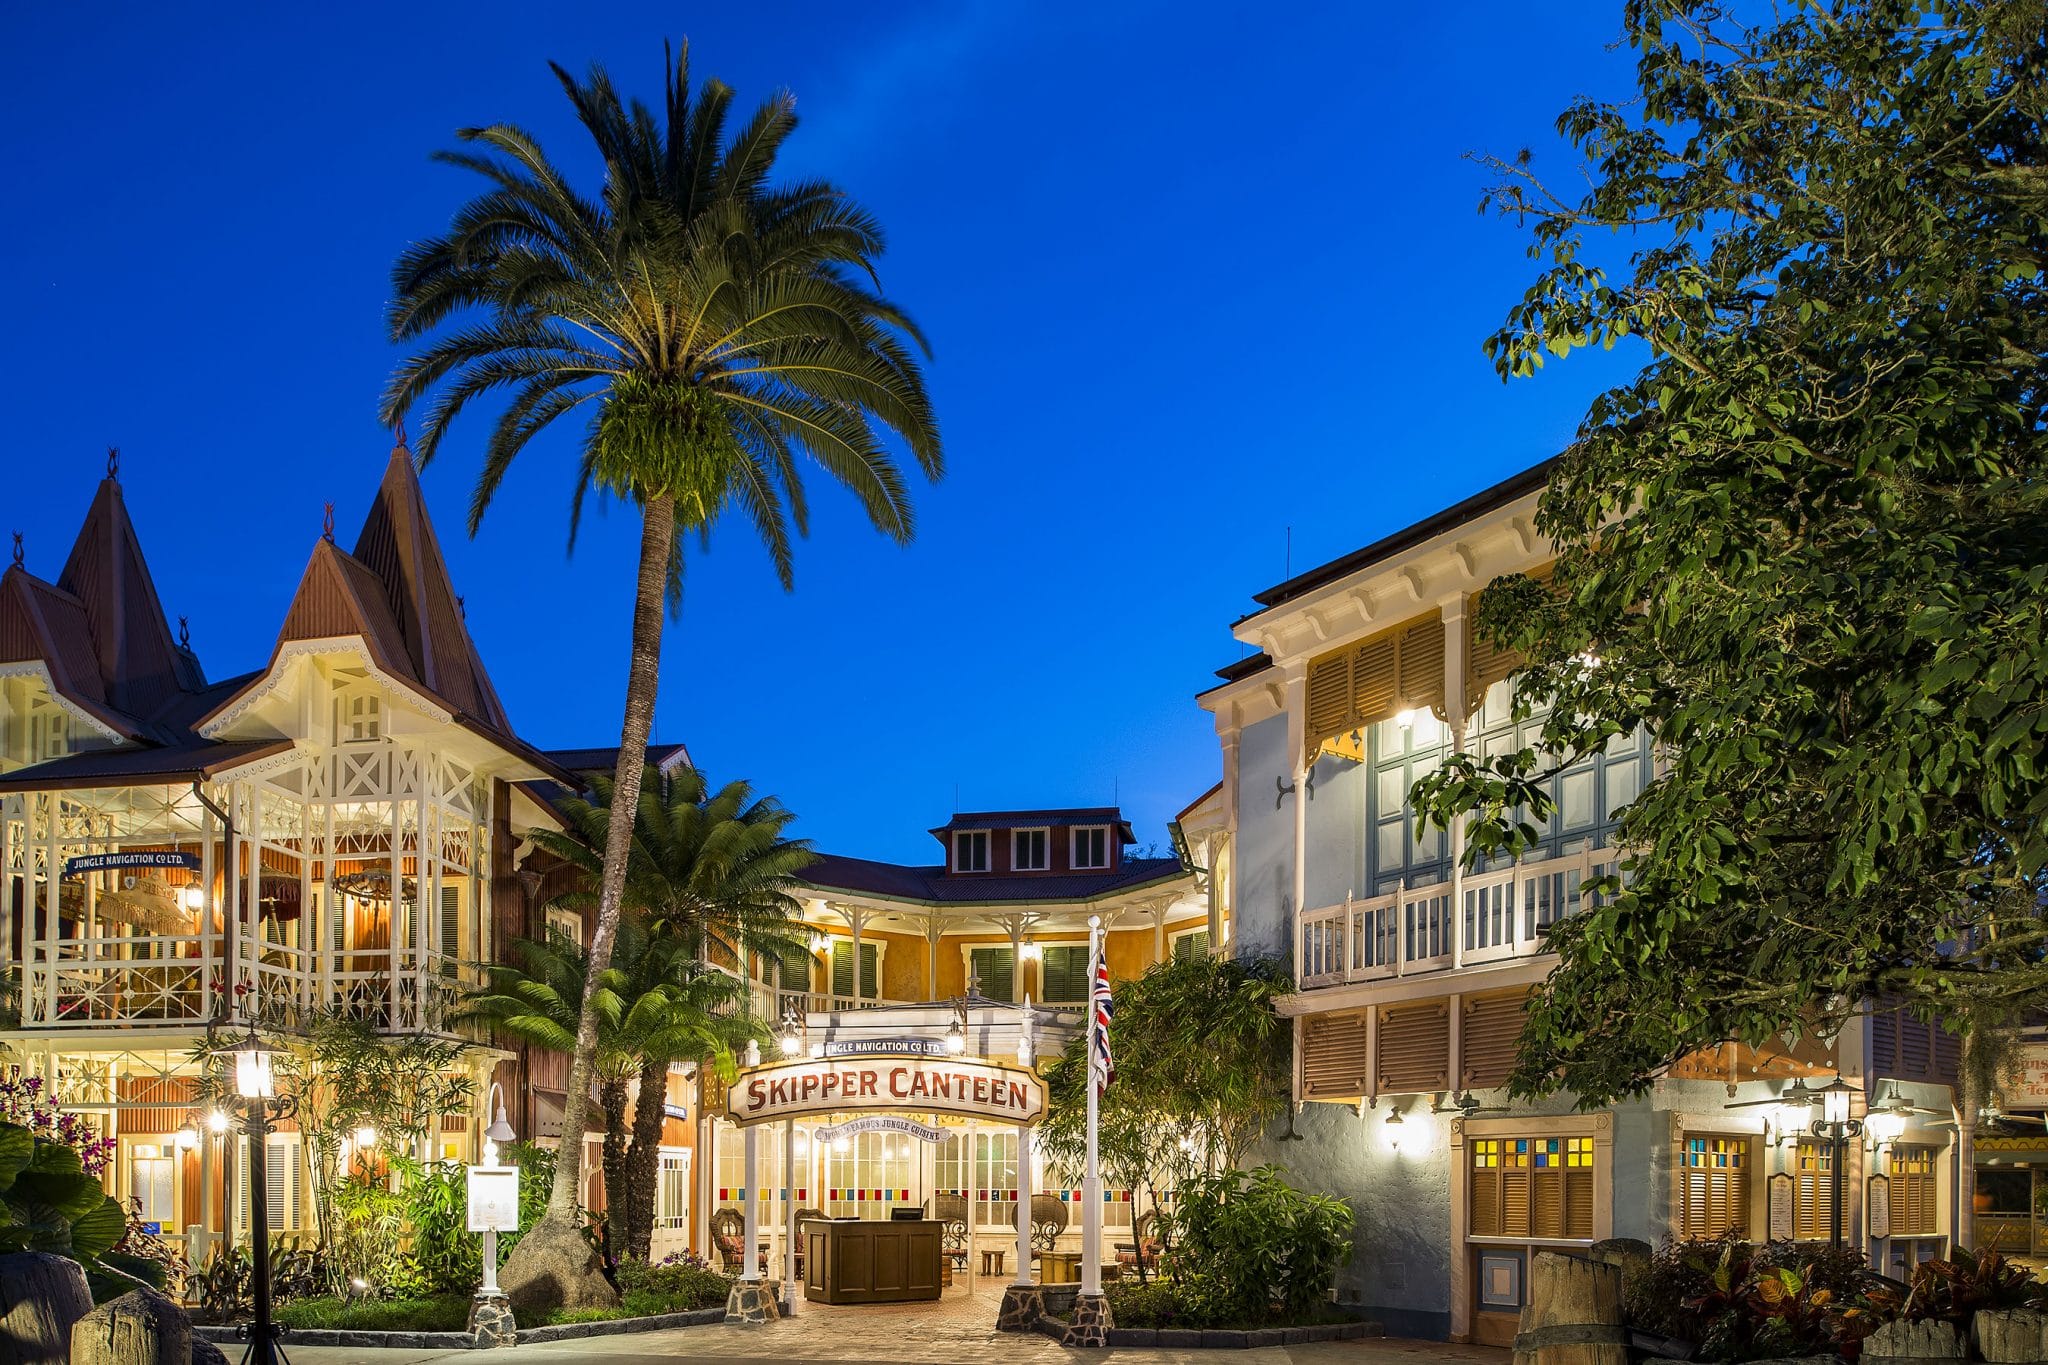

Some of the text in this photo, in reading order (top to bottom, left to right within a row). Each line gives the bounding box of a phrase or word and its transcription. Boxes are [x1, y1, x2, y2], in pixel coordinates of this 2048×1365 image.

[74, 857, 104, 869] JUNGLE
[106, 854, 154, 865] NAVIGATION
[825, 1043, 853, 1055] UNGLE
[855, 1042, 908, 1053] NAVIGATION
[747, 1066, 1029, 1112] SKIPPER CANTEEN
[850, 1119, 880, 1133] FAMOUS
[881, 1119, 909, 1131] JUNGLE
[910, 1125, 940, 1141] CUISINE
